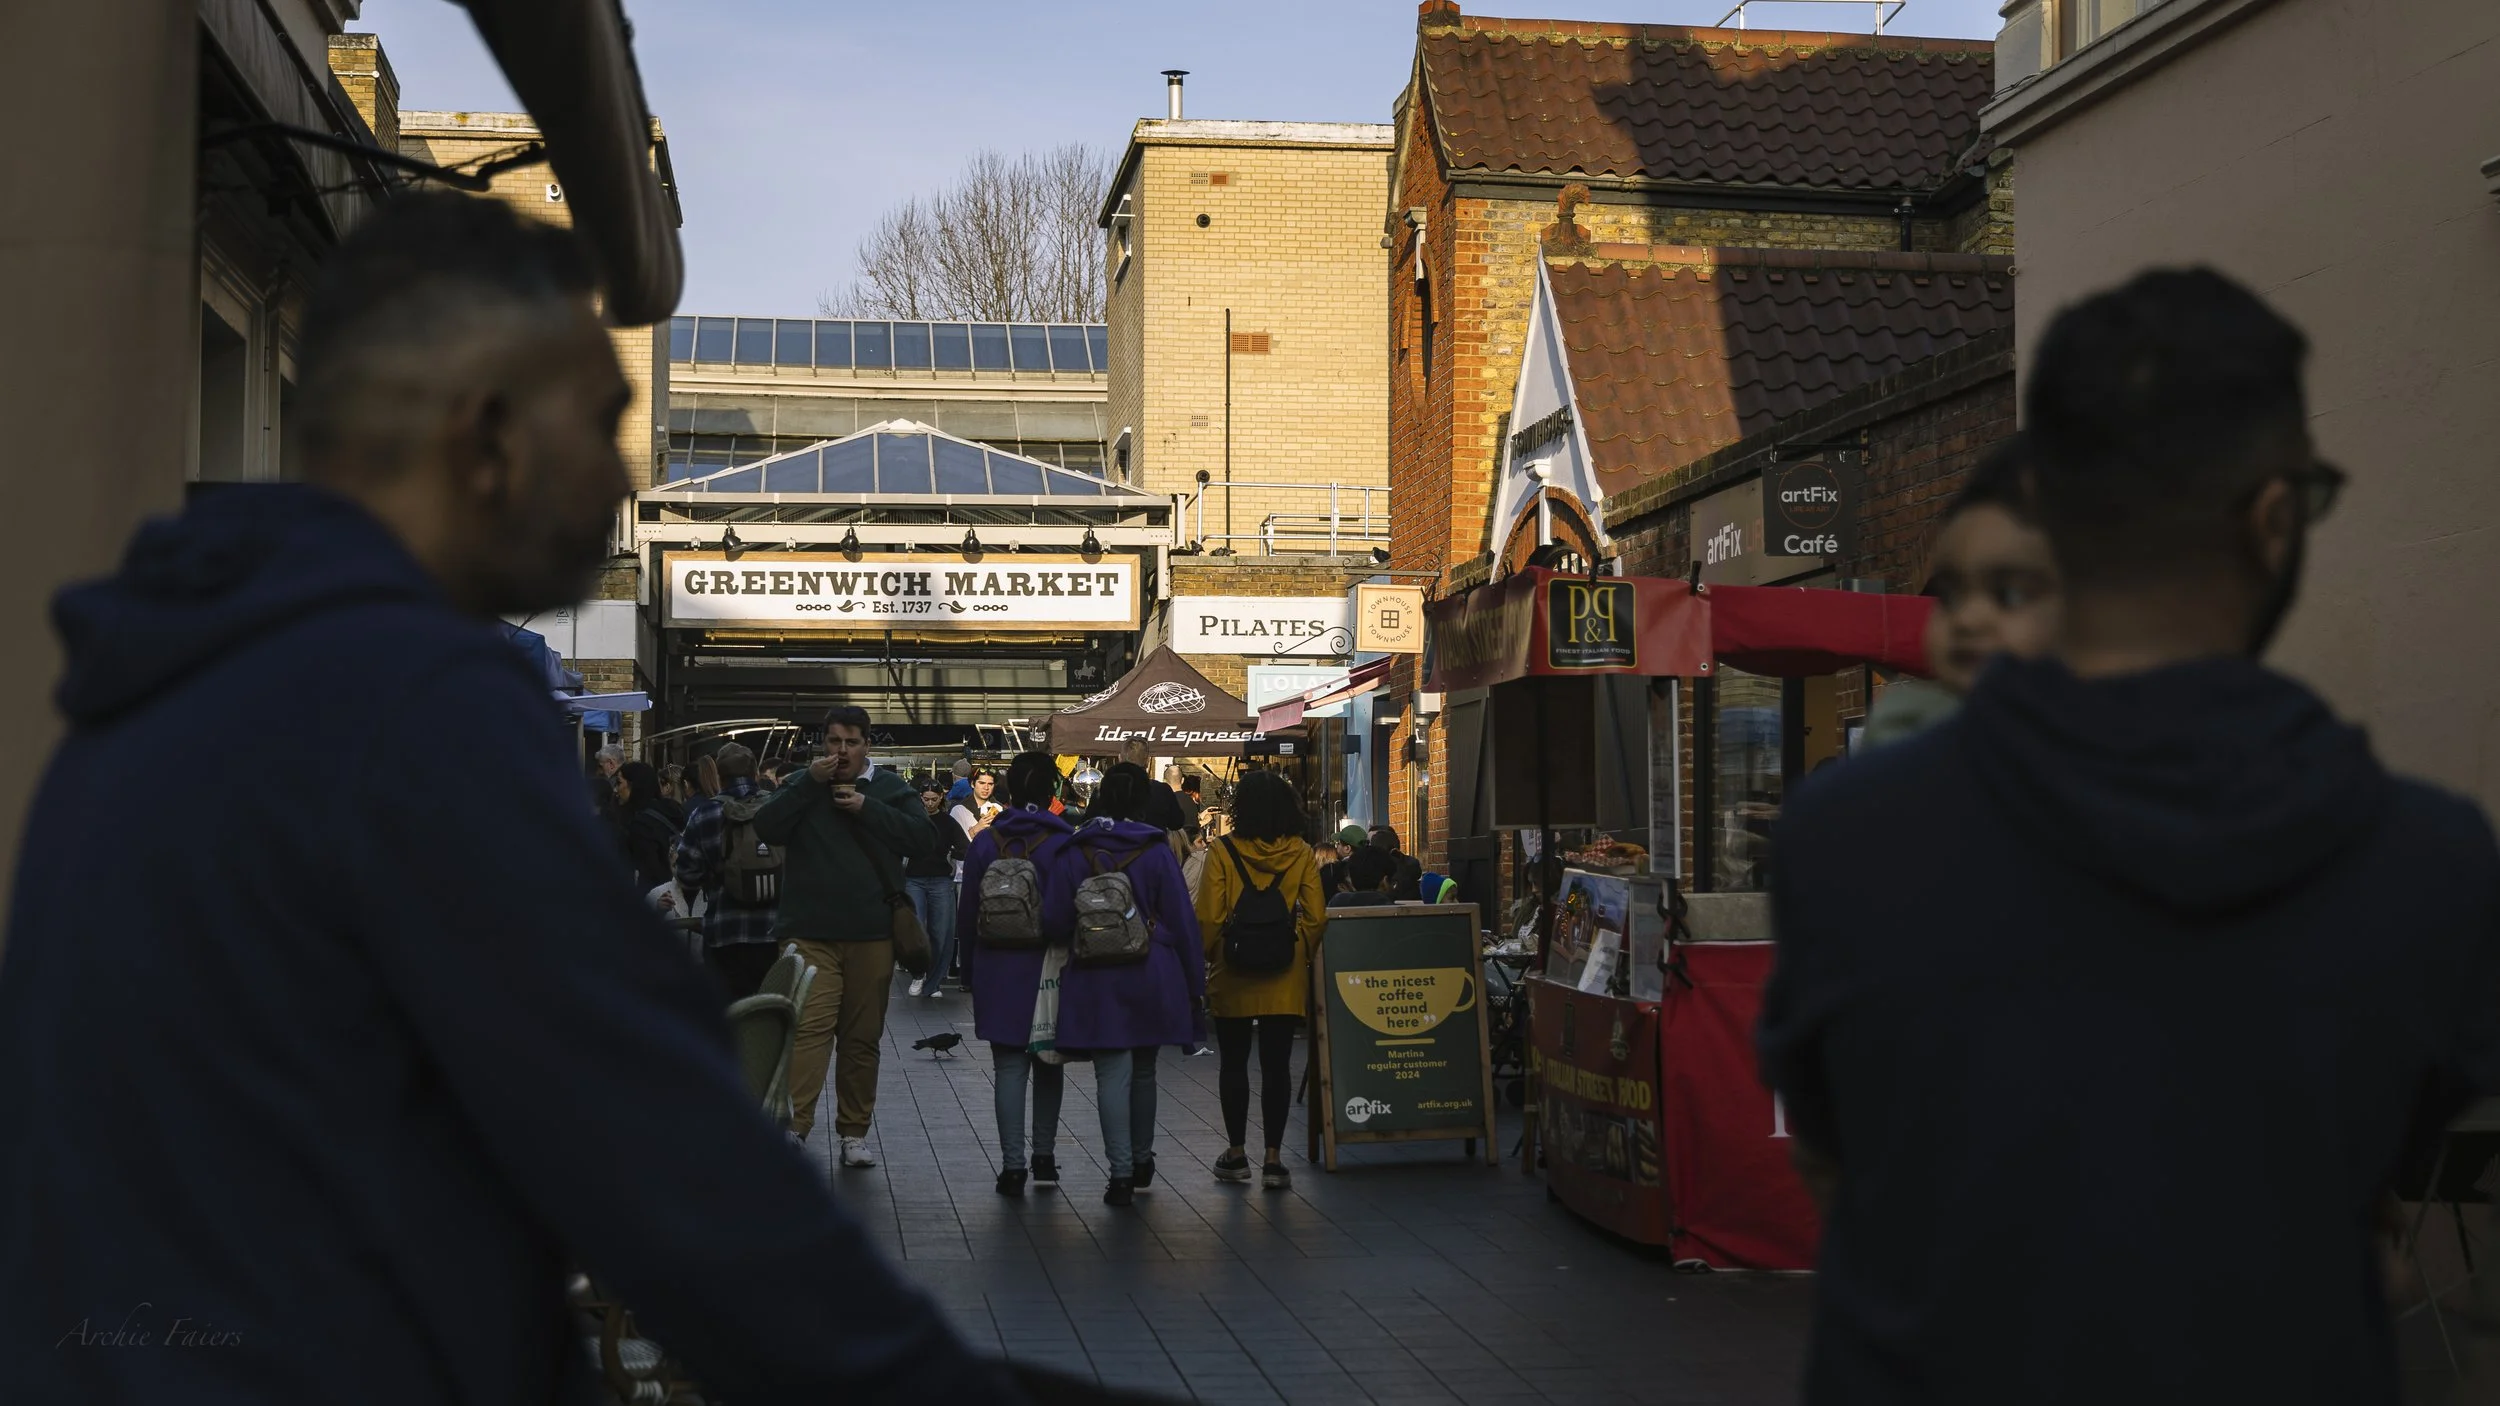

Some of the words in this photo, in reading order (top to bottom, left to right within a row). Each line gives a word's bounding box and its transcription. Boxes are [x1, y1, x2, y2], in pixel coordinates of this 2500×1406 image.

[1781, 486, 1838, 503] artFix
[1707, 522, 1742, 565] artFix
[1784, 534, 1838, 554] Café
[685, 569, 932, 597] GREENWICH
[945, 571, 1119, 597] MARKET
[873, 601, 899, 614] Est.
[902, 601, 932, 614] 1737
[1368, 595, 1413, 616] TOWNHOUSE
[1199, 614, 1325, 638] PILATES
[1368, 623, 1413, 643] TOWNHOUSE
[1556, 647, 1580, 655] FINEST
[1581, 647, 1609, 655] ITALIAN
[1611, 647, 1631, 655] FOOD
[1095, 725, 1156, 742] Ideal
[1161, 725, 1266, 748] Espresso
[1393, 975, 1435, 988] nicest
[1379, 990, 1424, 1001] coffee
[1376, 1003, 1427, 1015] around
[1388, 1050, 1424, 1059] Martina
[1367, 1062, 1401, 1072] regular
[1403, 1060, 1447, 1069] customer
[1395, 1070, 1420, 1080] 2024
[1347, 1099, 1392, 1115] artfix
[1417, 1099, 1473, 1109] artfix.org.uk
